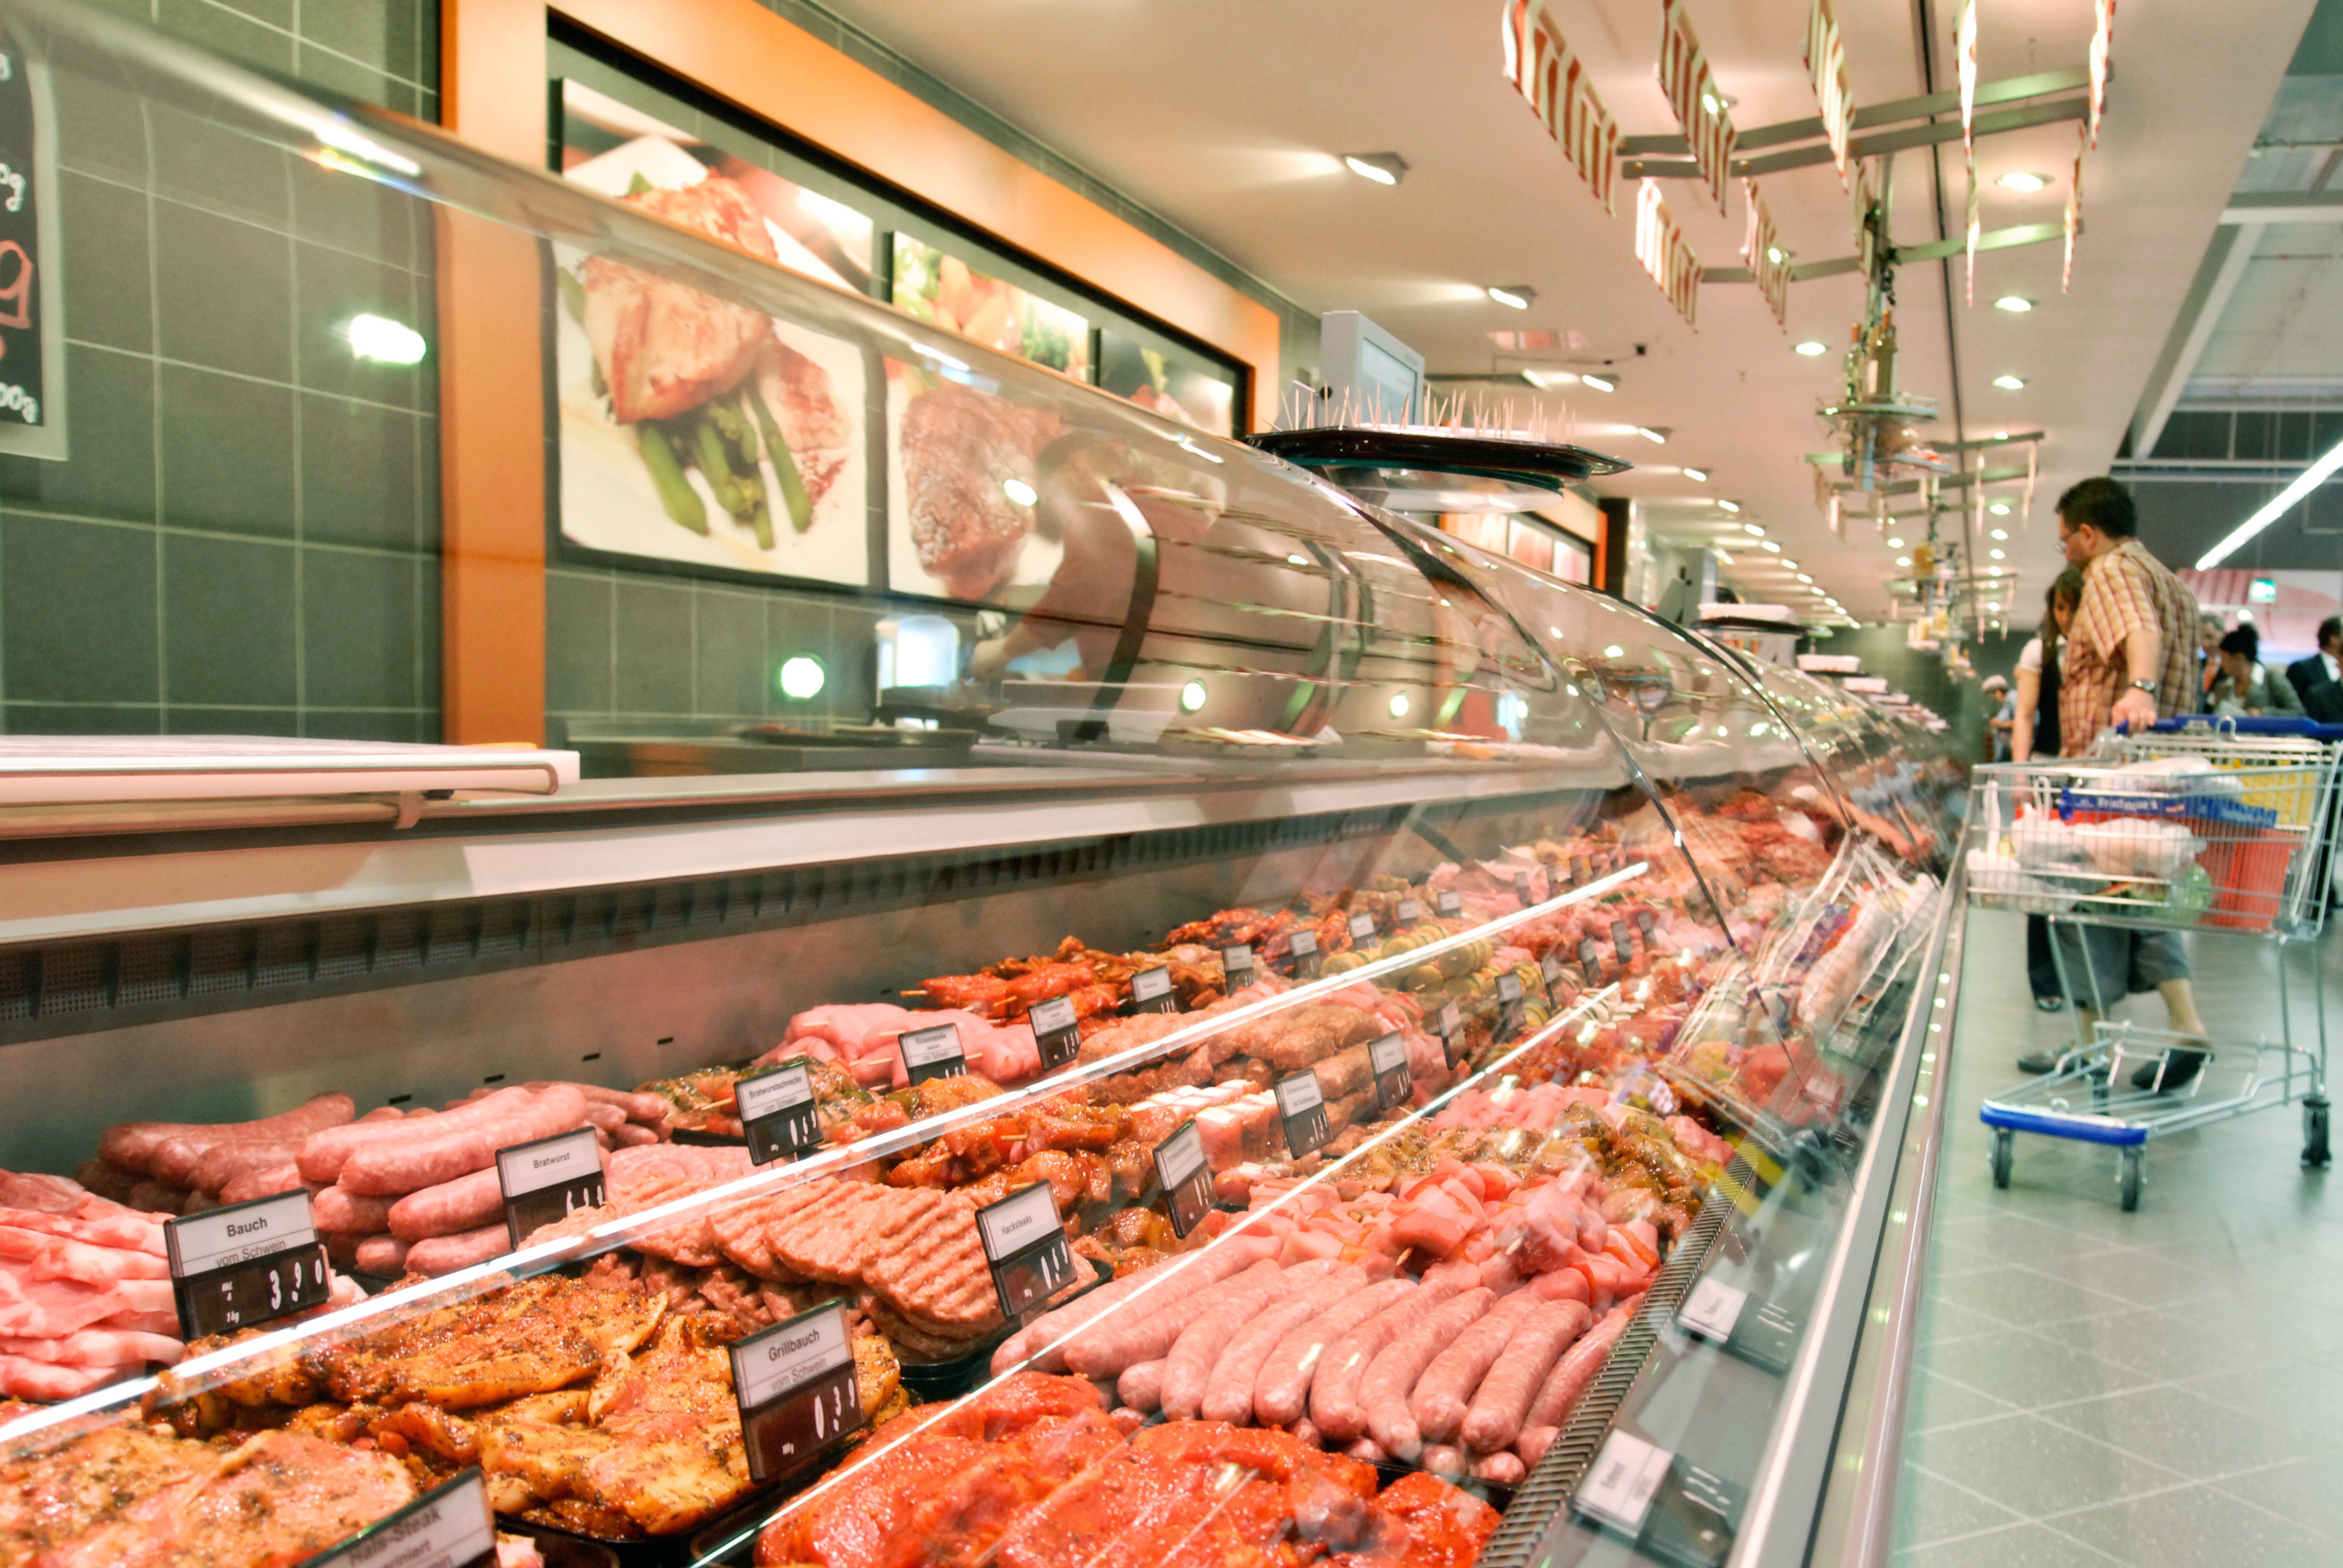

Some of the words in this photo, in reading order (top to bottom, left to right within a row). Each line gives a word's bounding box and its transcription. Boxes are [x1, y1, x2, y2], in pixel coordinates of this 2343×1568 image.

[533, 1152, 571, 1169] Bratwurst
[226, 1217, 268, 1238] Bauch
[1001, 1214, 1033, 1237] Hacksteaks
[216, 1251, 240, 1267] vom
[242, 1239, 286, 1261] Schwein
[768, 1329, 820, 1362] Grillbauch
[771, 1375, 790, 1391] vom
[791, 1356, 828, 1382] Schwein
